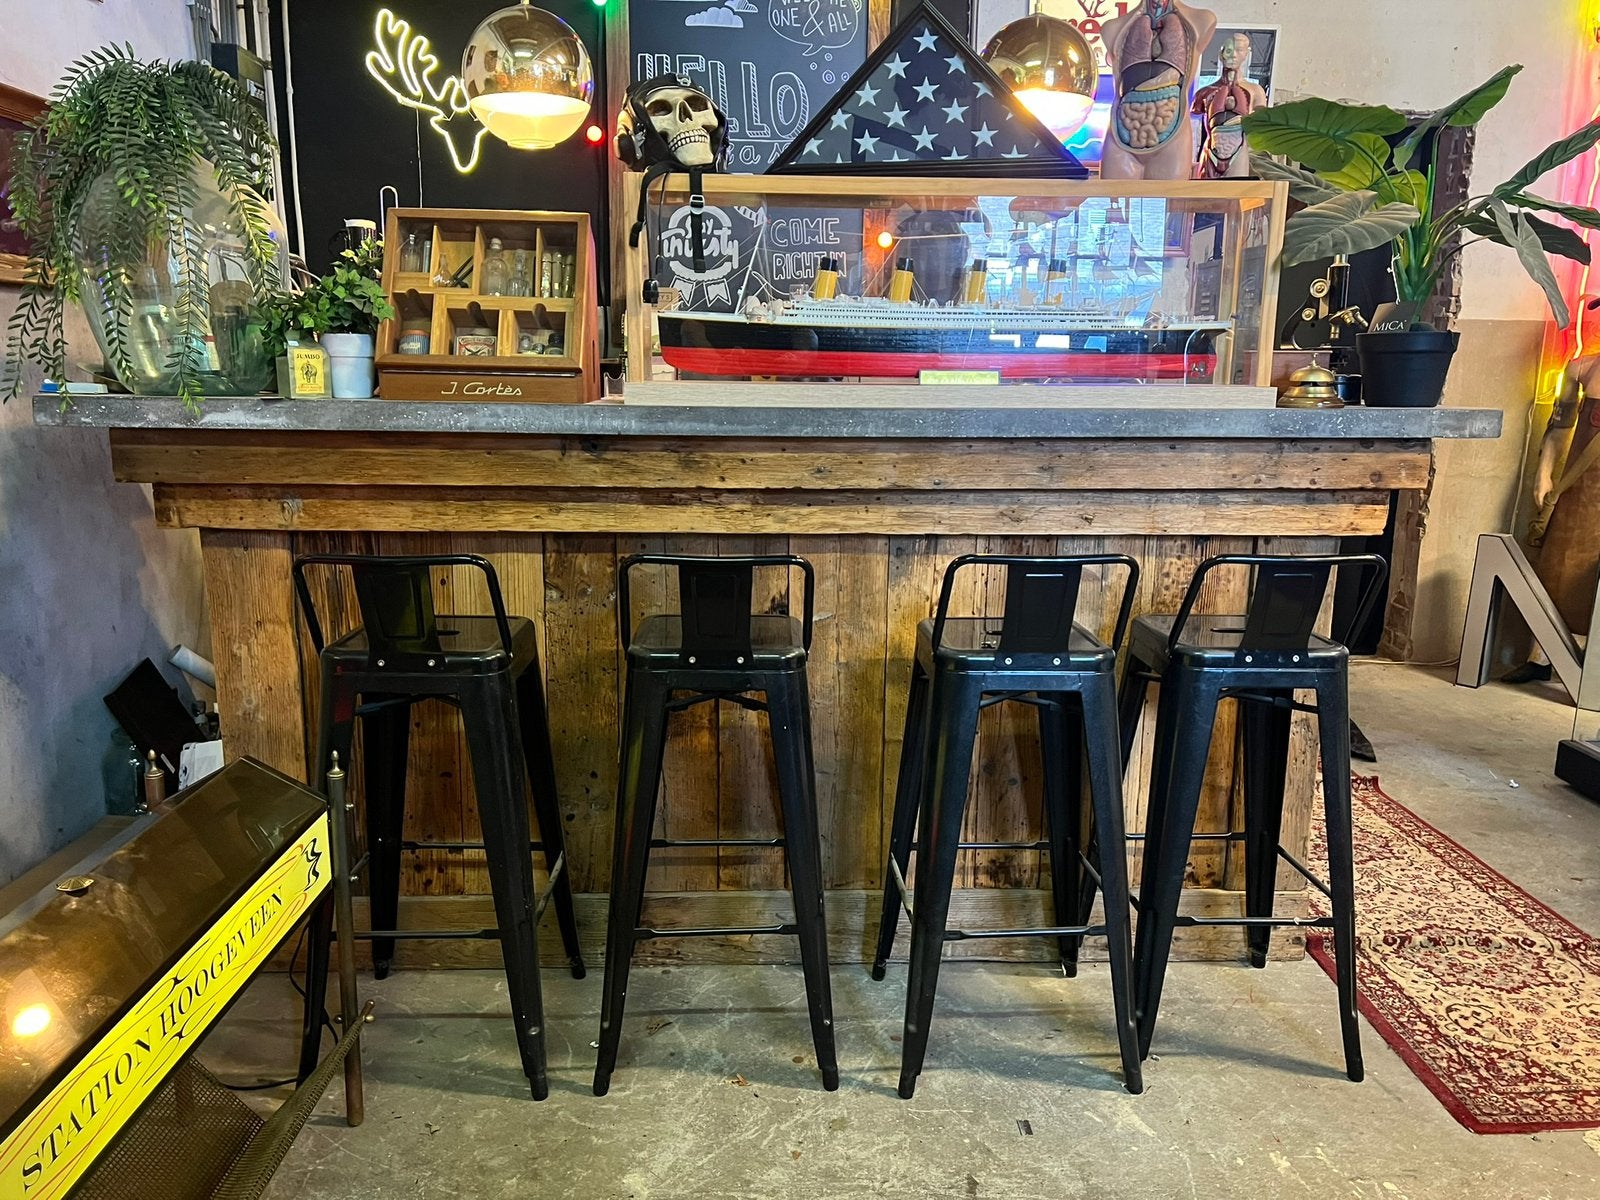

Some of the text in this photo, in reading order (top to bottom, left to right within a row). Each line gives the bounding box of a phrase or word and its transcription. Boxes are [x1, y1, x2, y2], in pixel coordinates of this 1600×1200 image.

[772, 0, 852, 37] ONE & ALL
[771, 218, 840, 247] COME
[657, 227, 739, 269] Thisty
[773, 251, 827, 280] RIGHT
[1373, 320, 1404, 332] MICA
[440, 381, 458, 395] J.
[22, 886, 284, 1194] STATION HOOGEVEEN
